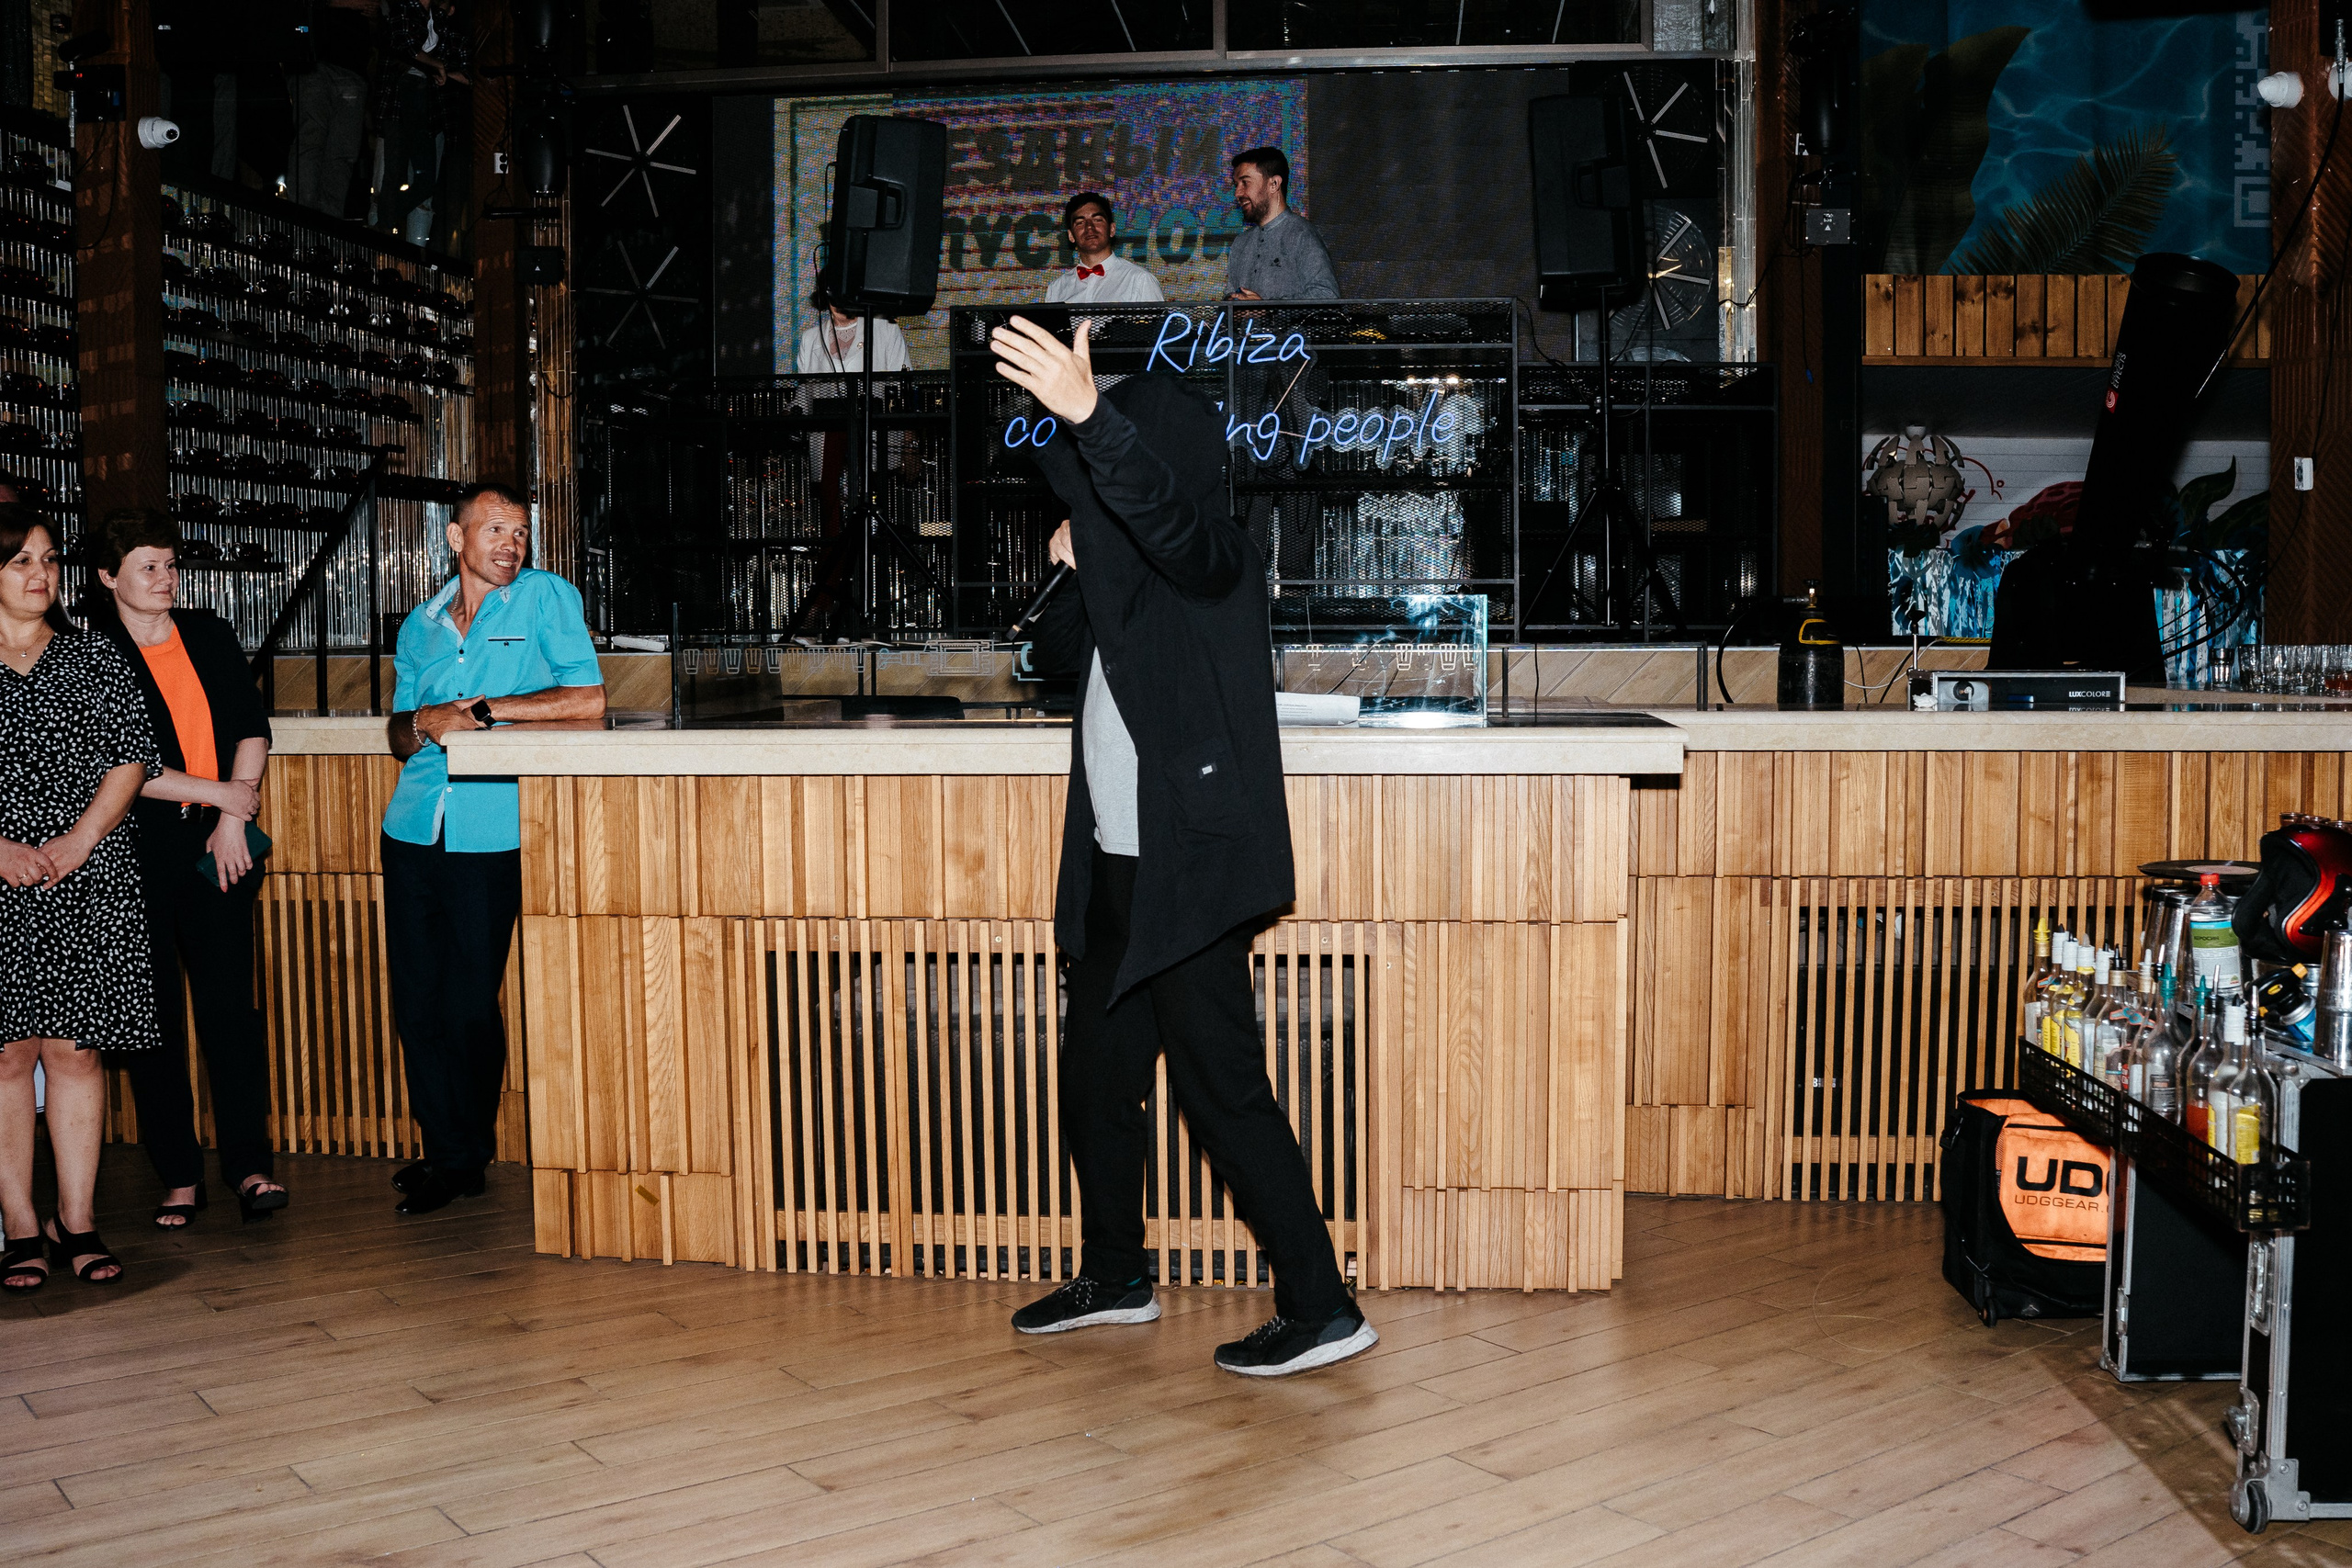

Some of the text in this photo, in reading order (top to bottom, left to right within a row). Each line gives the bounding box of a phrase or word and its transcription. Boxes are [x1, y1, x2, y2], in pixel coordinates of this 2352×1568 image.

[1147, 311, 1311, 373] Ribiza
[1300, 388, 1456, 464] people
[2015, 1194, 2111, 1213] UDGGEAR.
